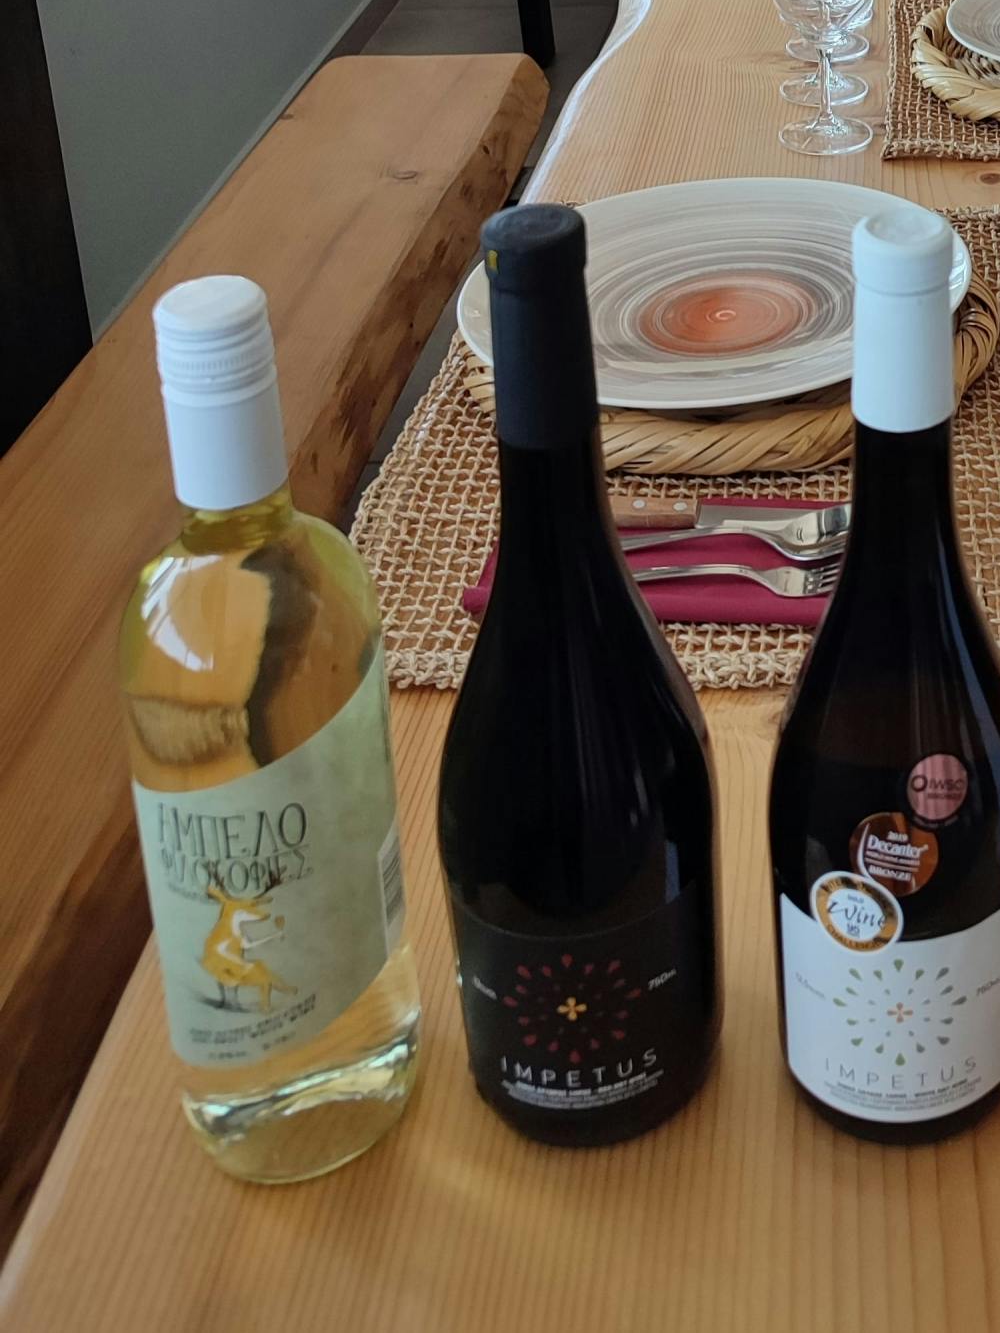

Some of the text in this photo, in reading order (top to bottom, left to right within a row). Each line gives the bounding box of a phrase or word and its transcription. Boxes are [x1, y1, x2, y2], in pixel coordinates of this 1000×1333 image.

[867, 834, 921, 859] Decanter
[500, 1048, 657, 1088] IMPETUS
[825, 1055, 977, 1090] IMPETUS
